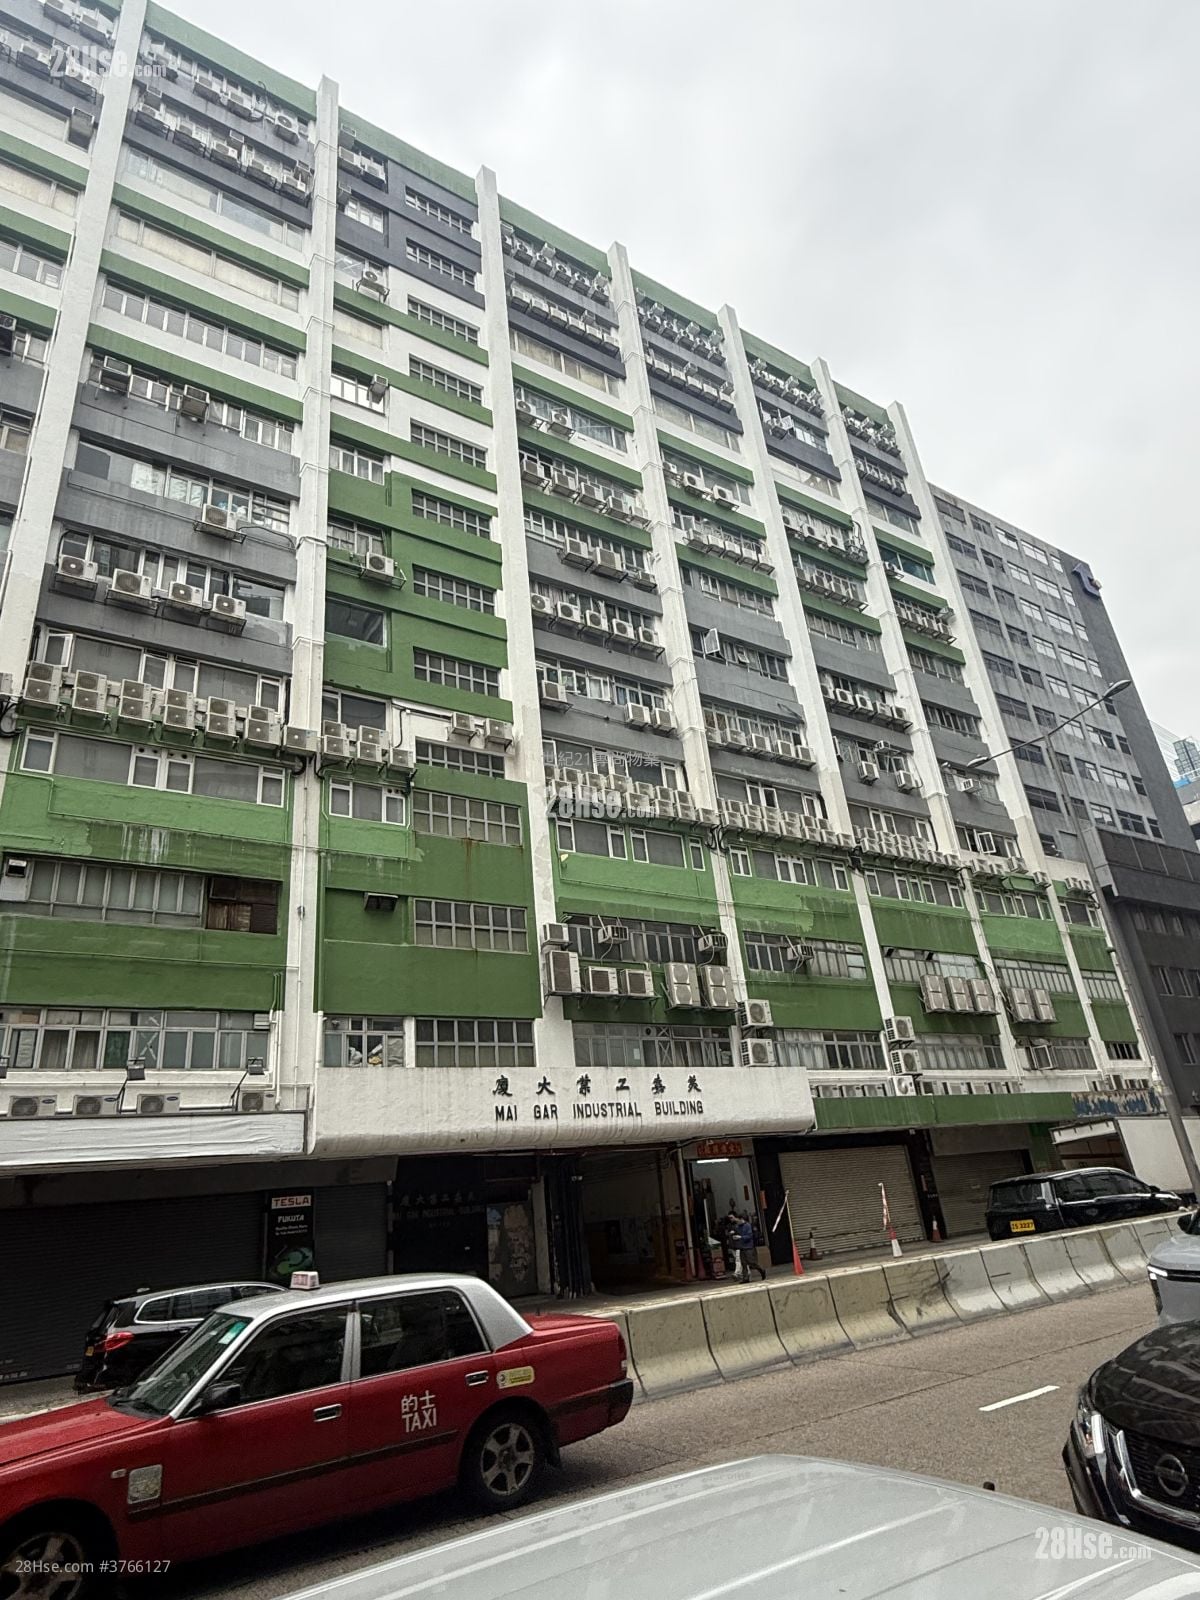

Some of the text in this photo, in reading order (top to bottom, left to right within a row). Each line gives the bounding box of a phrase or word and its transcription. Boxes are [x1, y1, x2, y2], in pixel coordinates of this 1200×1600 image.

[495, 1100, 704, 1121] MAI GAR INDUSTRIAL BUILDING
[273, 1196, 310, 1207] TESLA
[401, 1389, 436, 1413] 的士
[401, 1407, 437, 1433] TAXI
